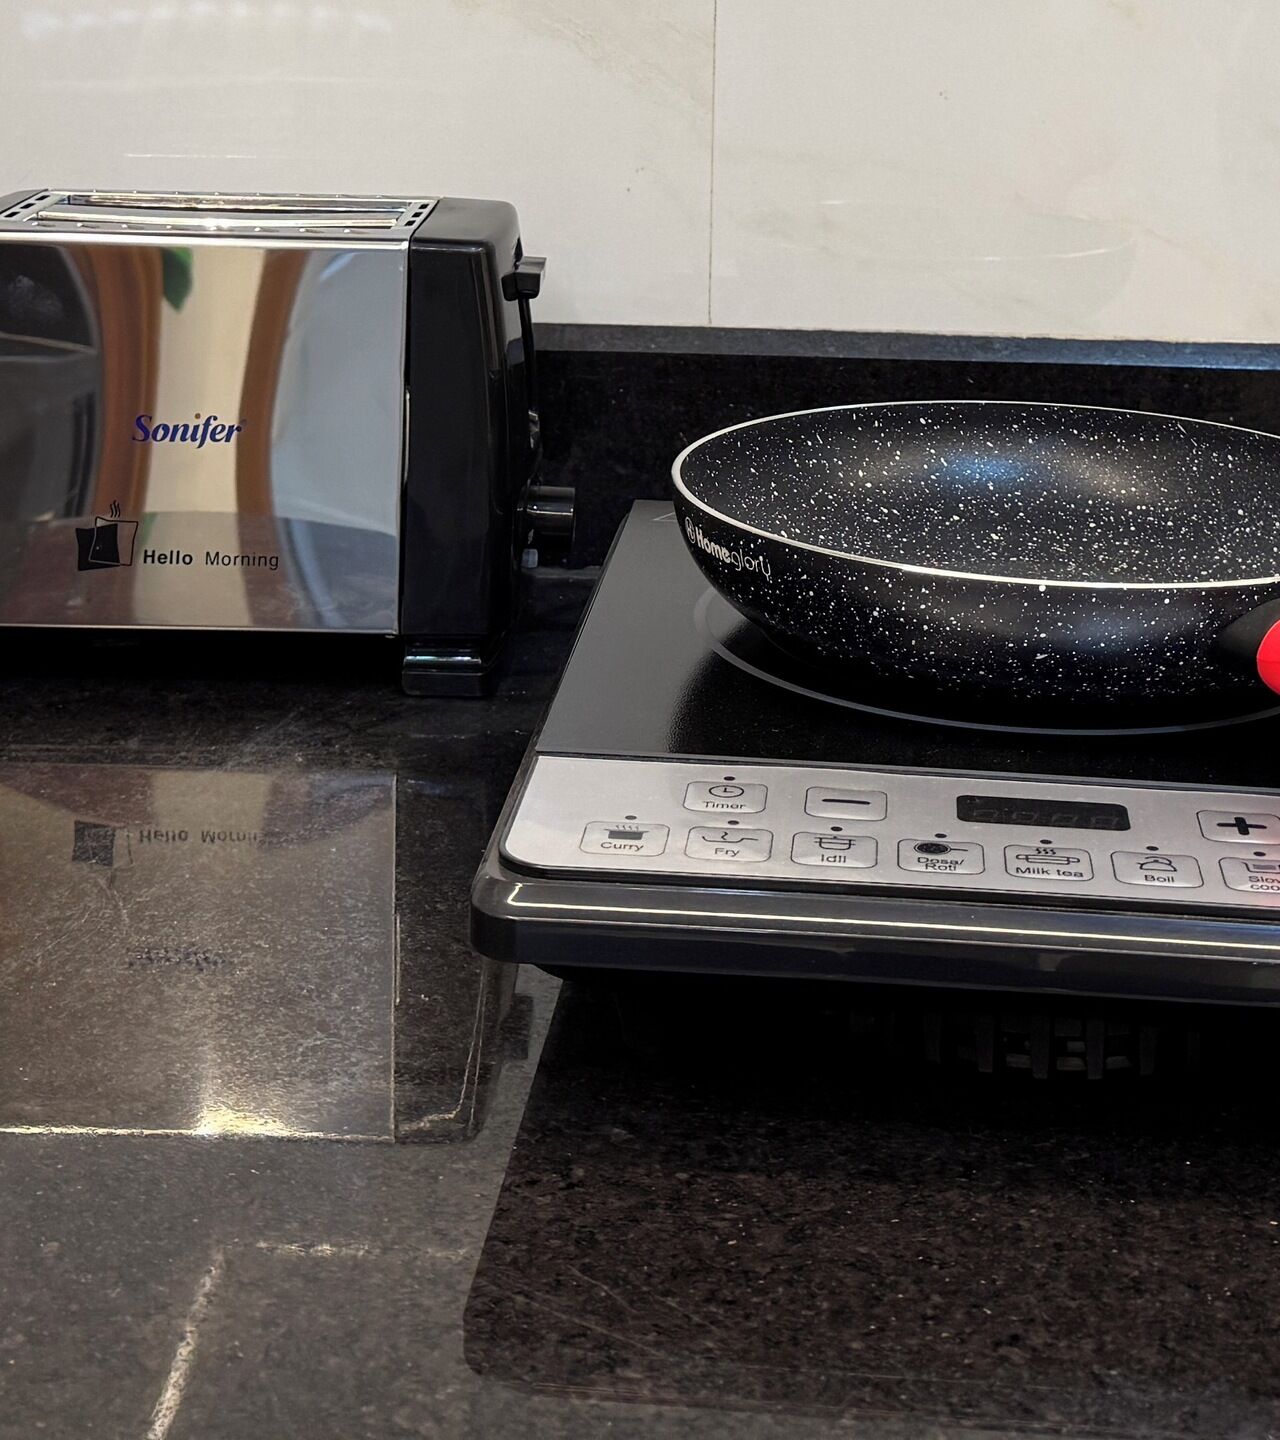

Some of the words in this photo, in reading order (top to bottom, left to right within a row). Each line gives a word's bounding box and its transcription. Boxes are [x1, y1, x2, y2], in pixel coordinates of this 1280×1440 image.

[132, 413, 243, 448] Sonifer
[143, 549, 193, 566] Hello
[205, 551, 279, 570] Morning
[703, 800, 747, 810] Timer
[600, 841, 644, 852] Curry
[714, 847, 740, 858] Fry
[820, 854, 847, 864] Idli
[925, 863, 957, 872] Roti
[1015, 866, 1051, 876] Milk
[1056, 868, 1084, 878] tea
[1144, 874, 1175, 883] Boil
